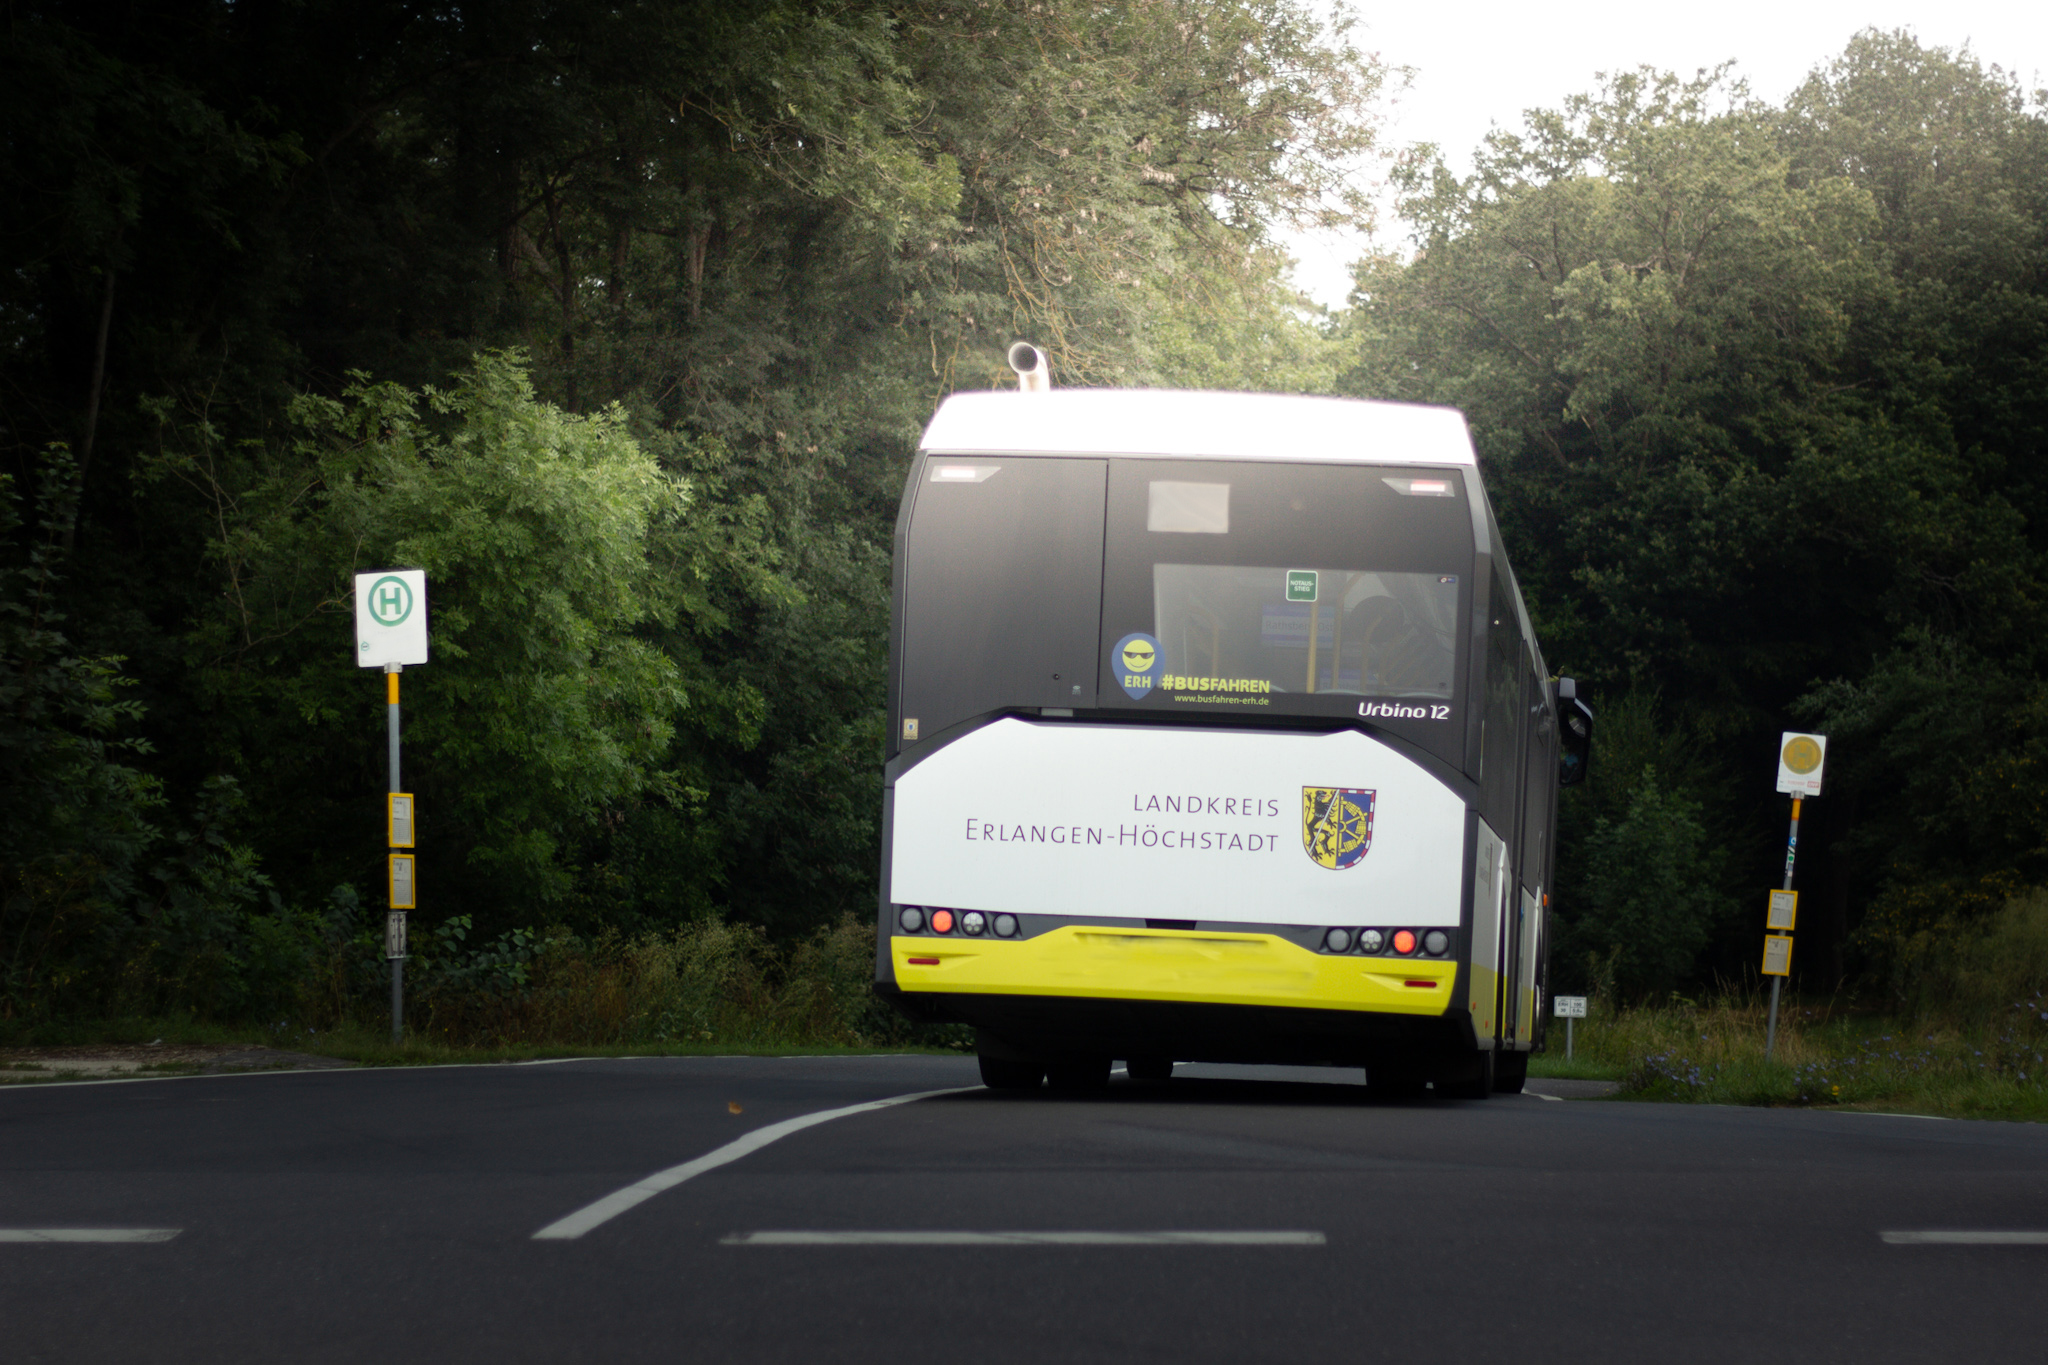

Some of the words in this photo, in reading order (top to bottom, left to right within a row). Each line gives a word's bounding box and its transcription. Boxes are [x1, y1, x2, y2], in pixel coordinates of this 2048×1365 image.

[379, 587, 402, 616] H
[1265, 620, 1312, 632] Rathsber
[1124, 675, 1152, 689] ERH
[1161, 674, 1270, 694] #BUSFAHREN
[1174, 694, 1270, 706] www.busfahren-erh.de
[1358, 702, 1426, 719] Urbino
[1429, 704, 1451, 720] 12
[1134, 794, 1279, 817] LANDKREIS
[966, 818, 1279, 852] ERLANGEN-HÖCHSTADT
